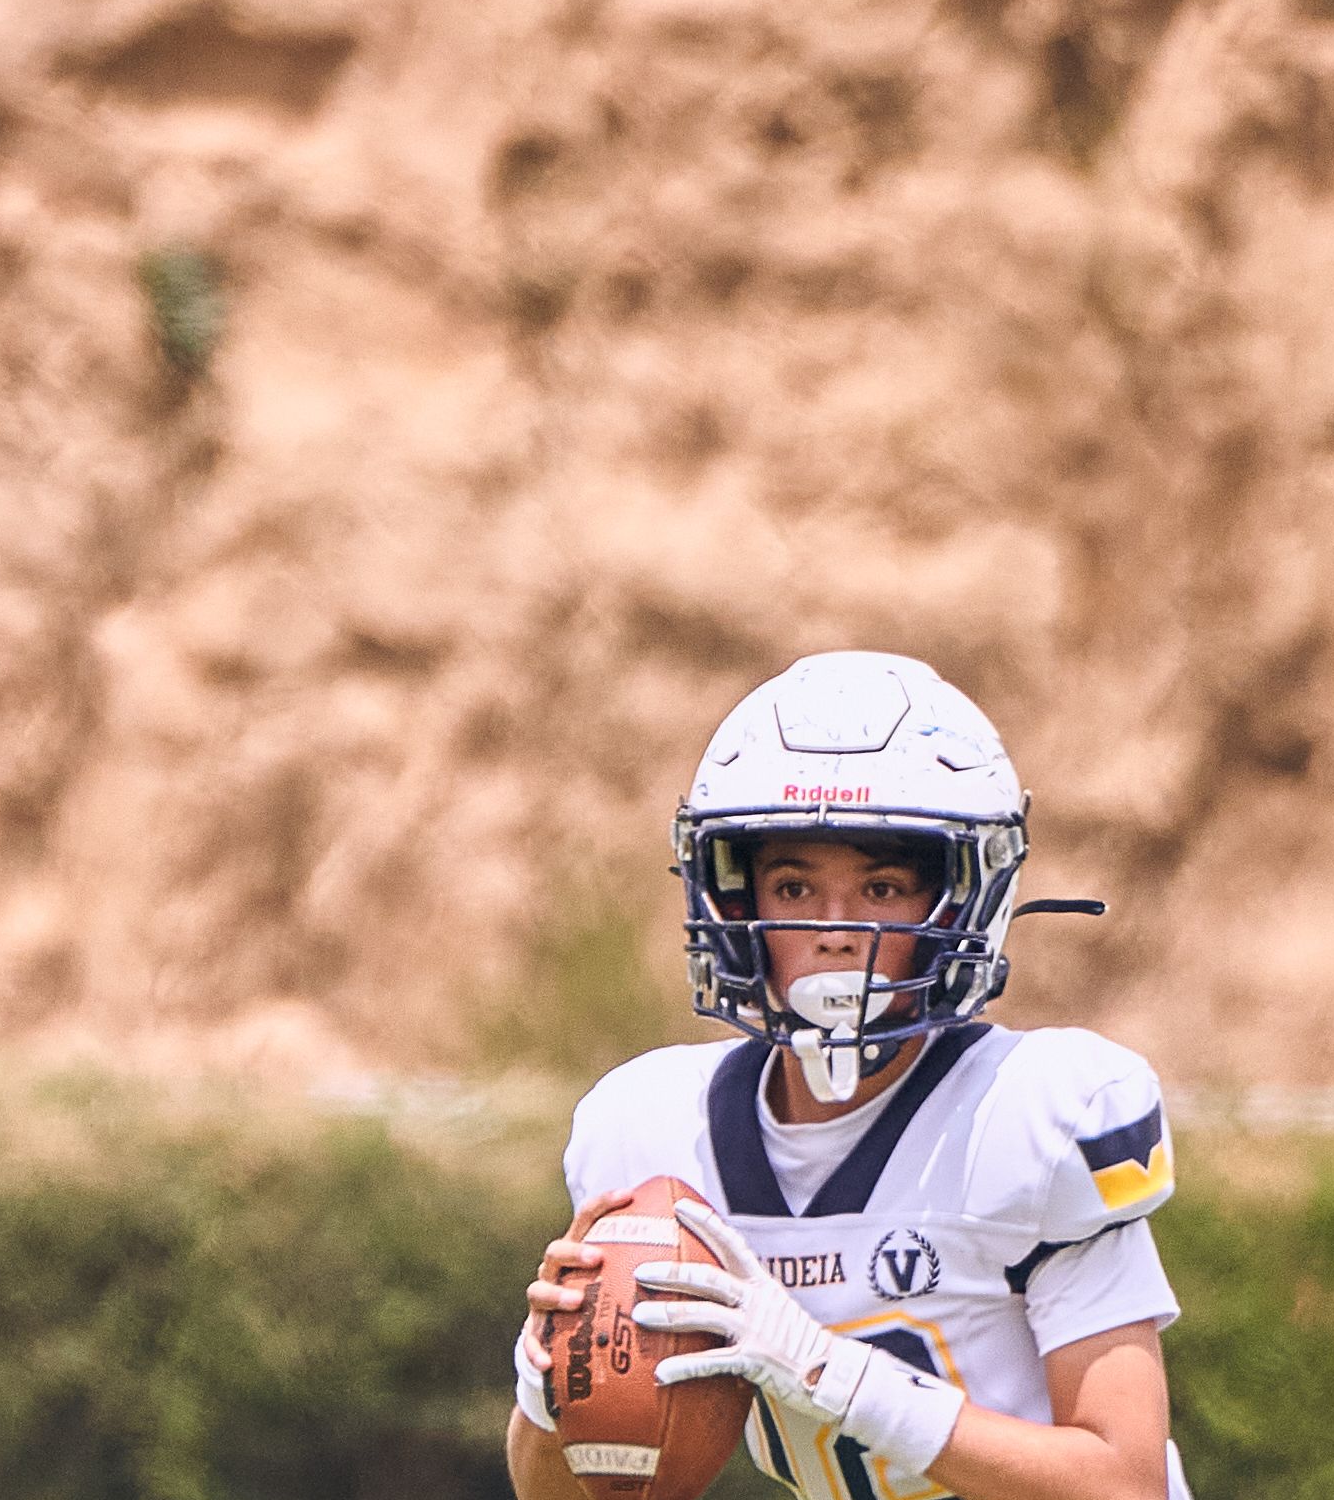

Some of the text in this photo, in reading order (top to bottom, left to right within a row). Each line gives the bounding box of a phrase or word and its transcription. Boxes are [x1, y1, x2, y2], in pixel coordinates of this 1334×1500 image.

[784, 784, 870, 802] Riddell
[758, 1252, 846, 1288] IDEIA
[880, 1249, 921, 1292] V
[610, 1304, 632, 1375] GST
